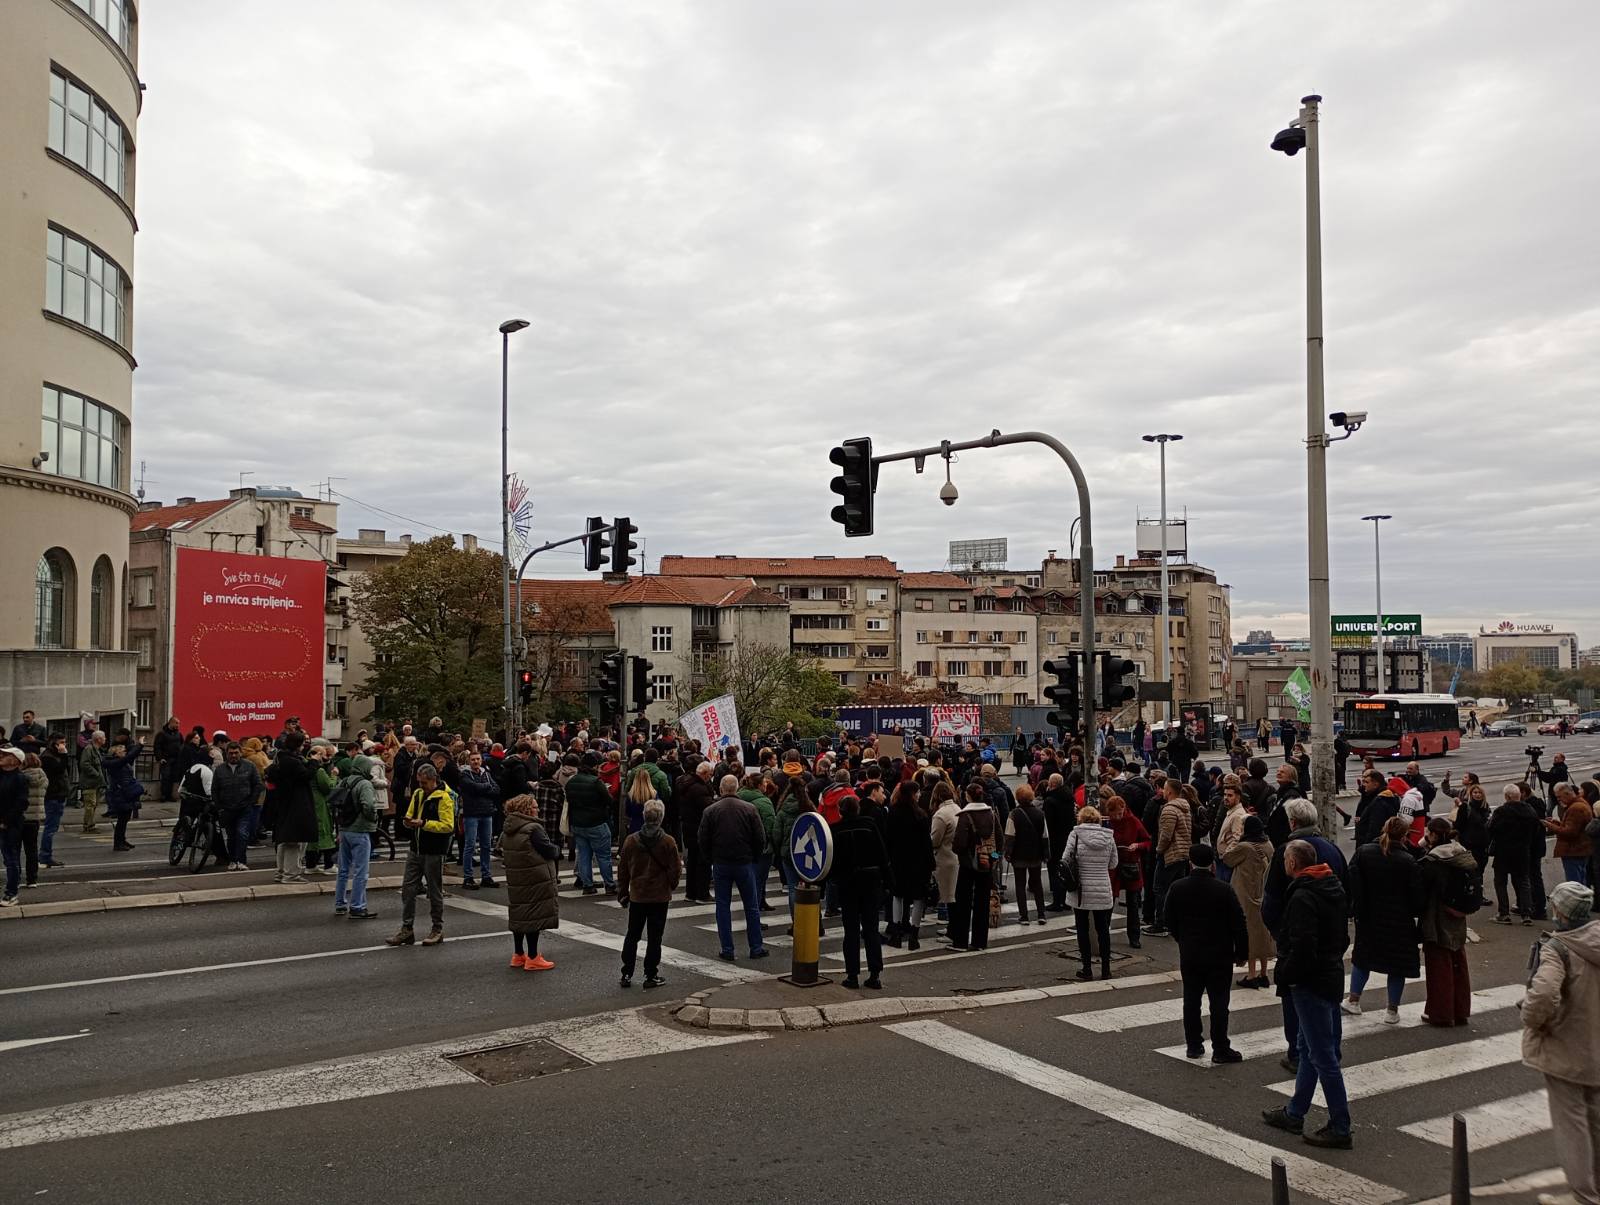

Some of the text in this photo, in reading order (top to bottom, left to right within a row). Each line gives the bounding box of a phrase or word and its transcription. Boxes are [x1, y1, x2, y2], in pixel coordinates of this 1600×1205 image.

[222, 567, 238, 586] Sve
[253, 572, 260, 583] ti
[203, 591, 302, 610] je mrvica strpljenja...
[1516, 624, 1554, 632] HUAWEI
[219, 701, 246, 710] Vidimo
[257, 700, 284, 709] uskoro!
[227, 711, 276, 724] Tvoja Plazma
[707, 704, 722, 738] БОРБА
[881, 717, 923, 729] FASADE
[932, 713, 980, 725] ADVNT
[701, 708, 716, 741] ТРАЈЕ
